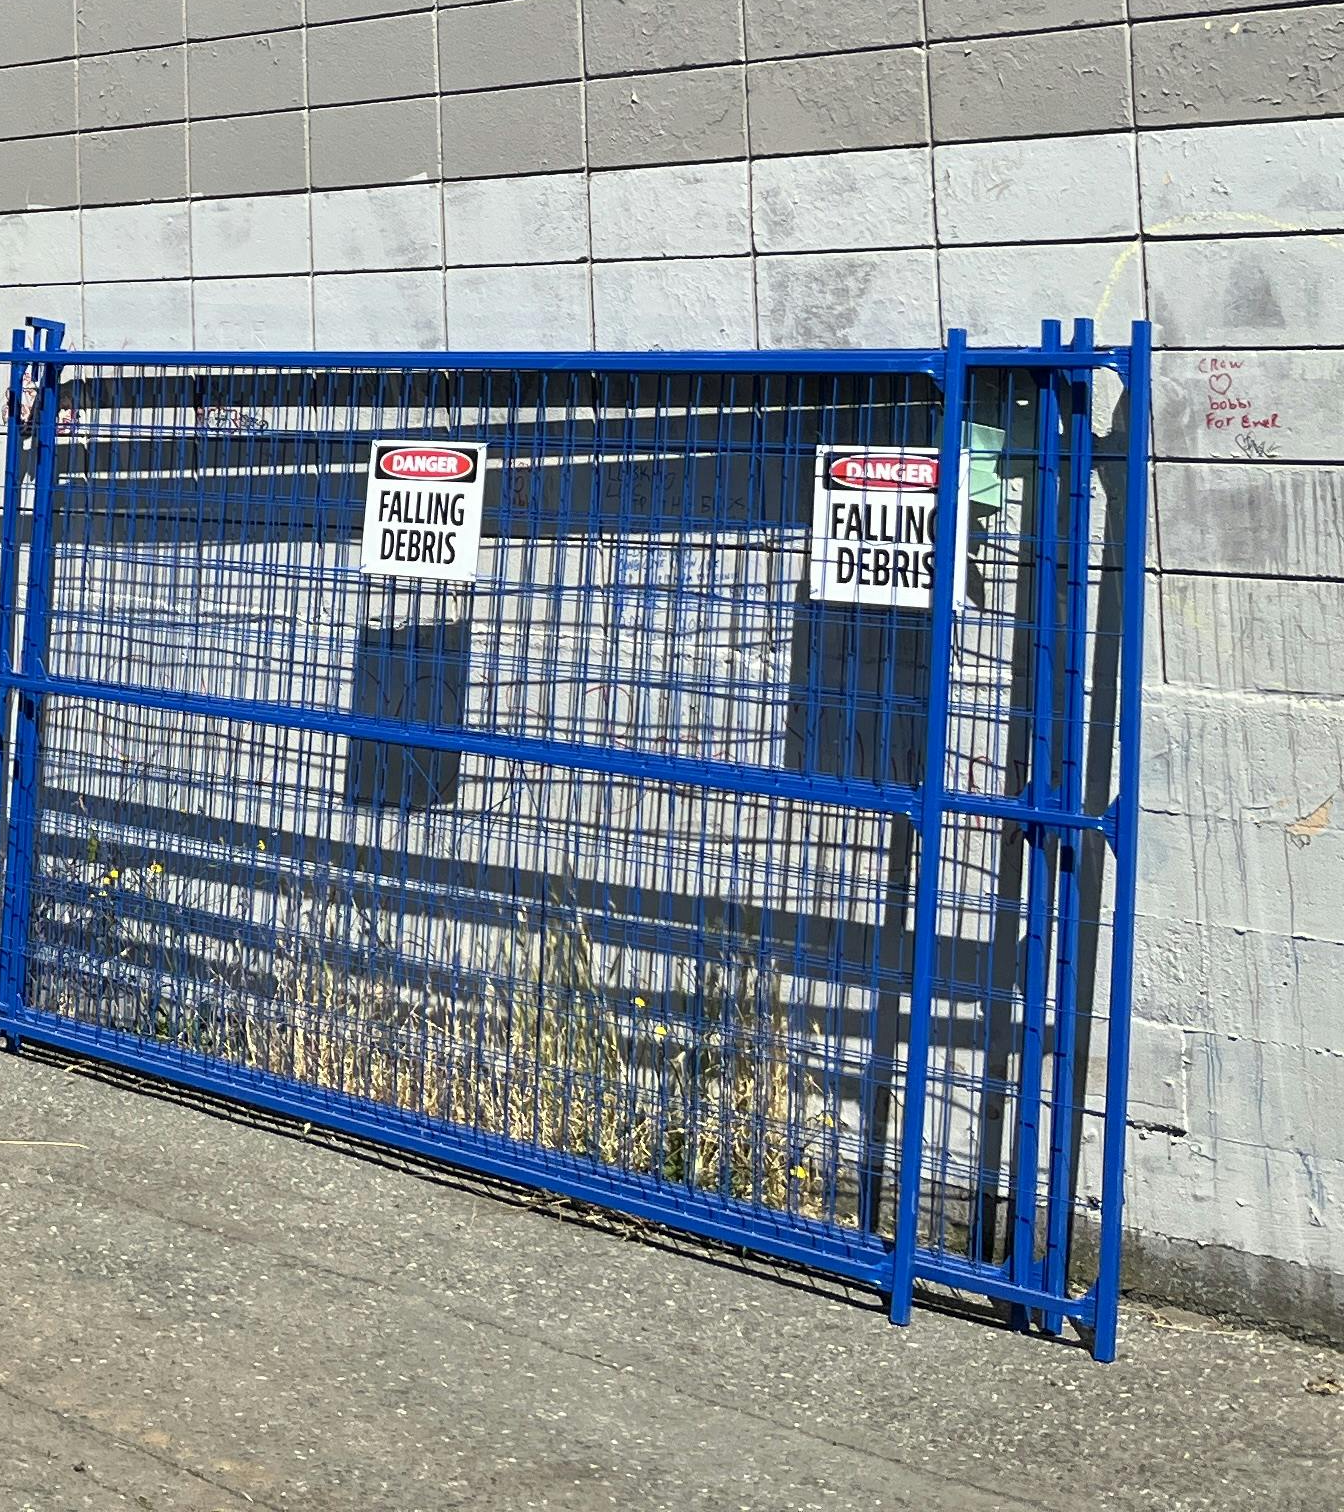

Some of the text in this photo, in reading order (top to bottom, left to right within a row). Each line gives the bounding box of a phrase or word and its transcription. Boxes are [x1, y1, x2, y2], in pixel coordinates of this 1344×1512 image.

[392, 455, 458, 473] DANGER
[845, 461, 933, 483] DANGER
[378, 490, 465, 526] FALLING
[380, 528, 457, 565] DEBRIS
[836, 546, 935, 589] DEBRIS
